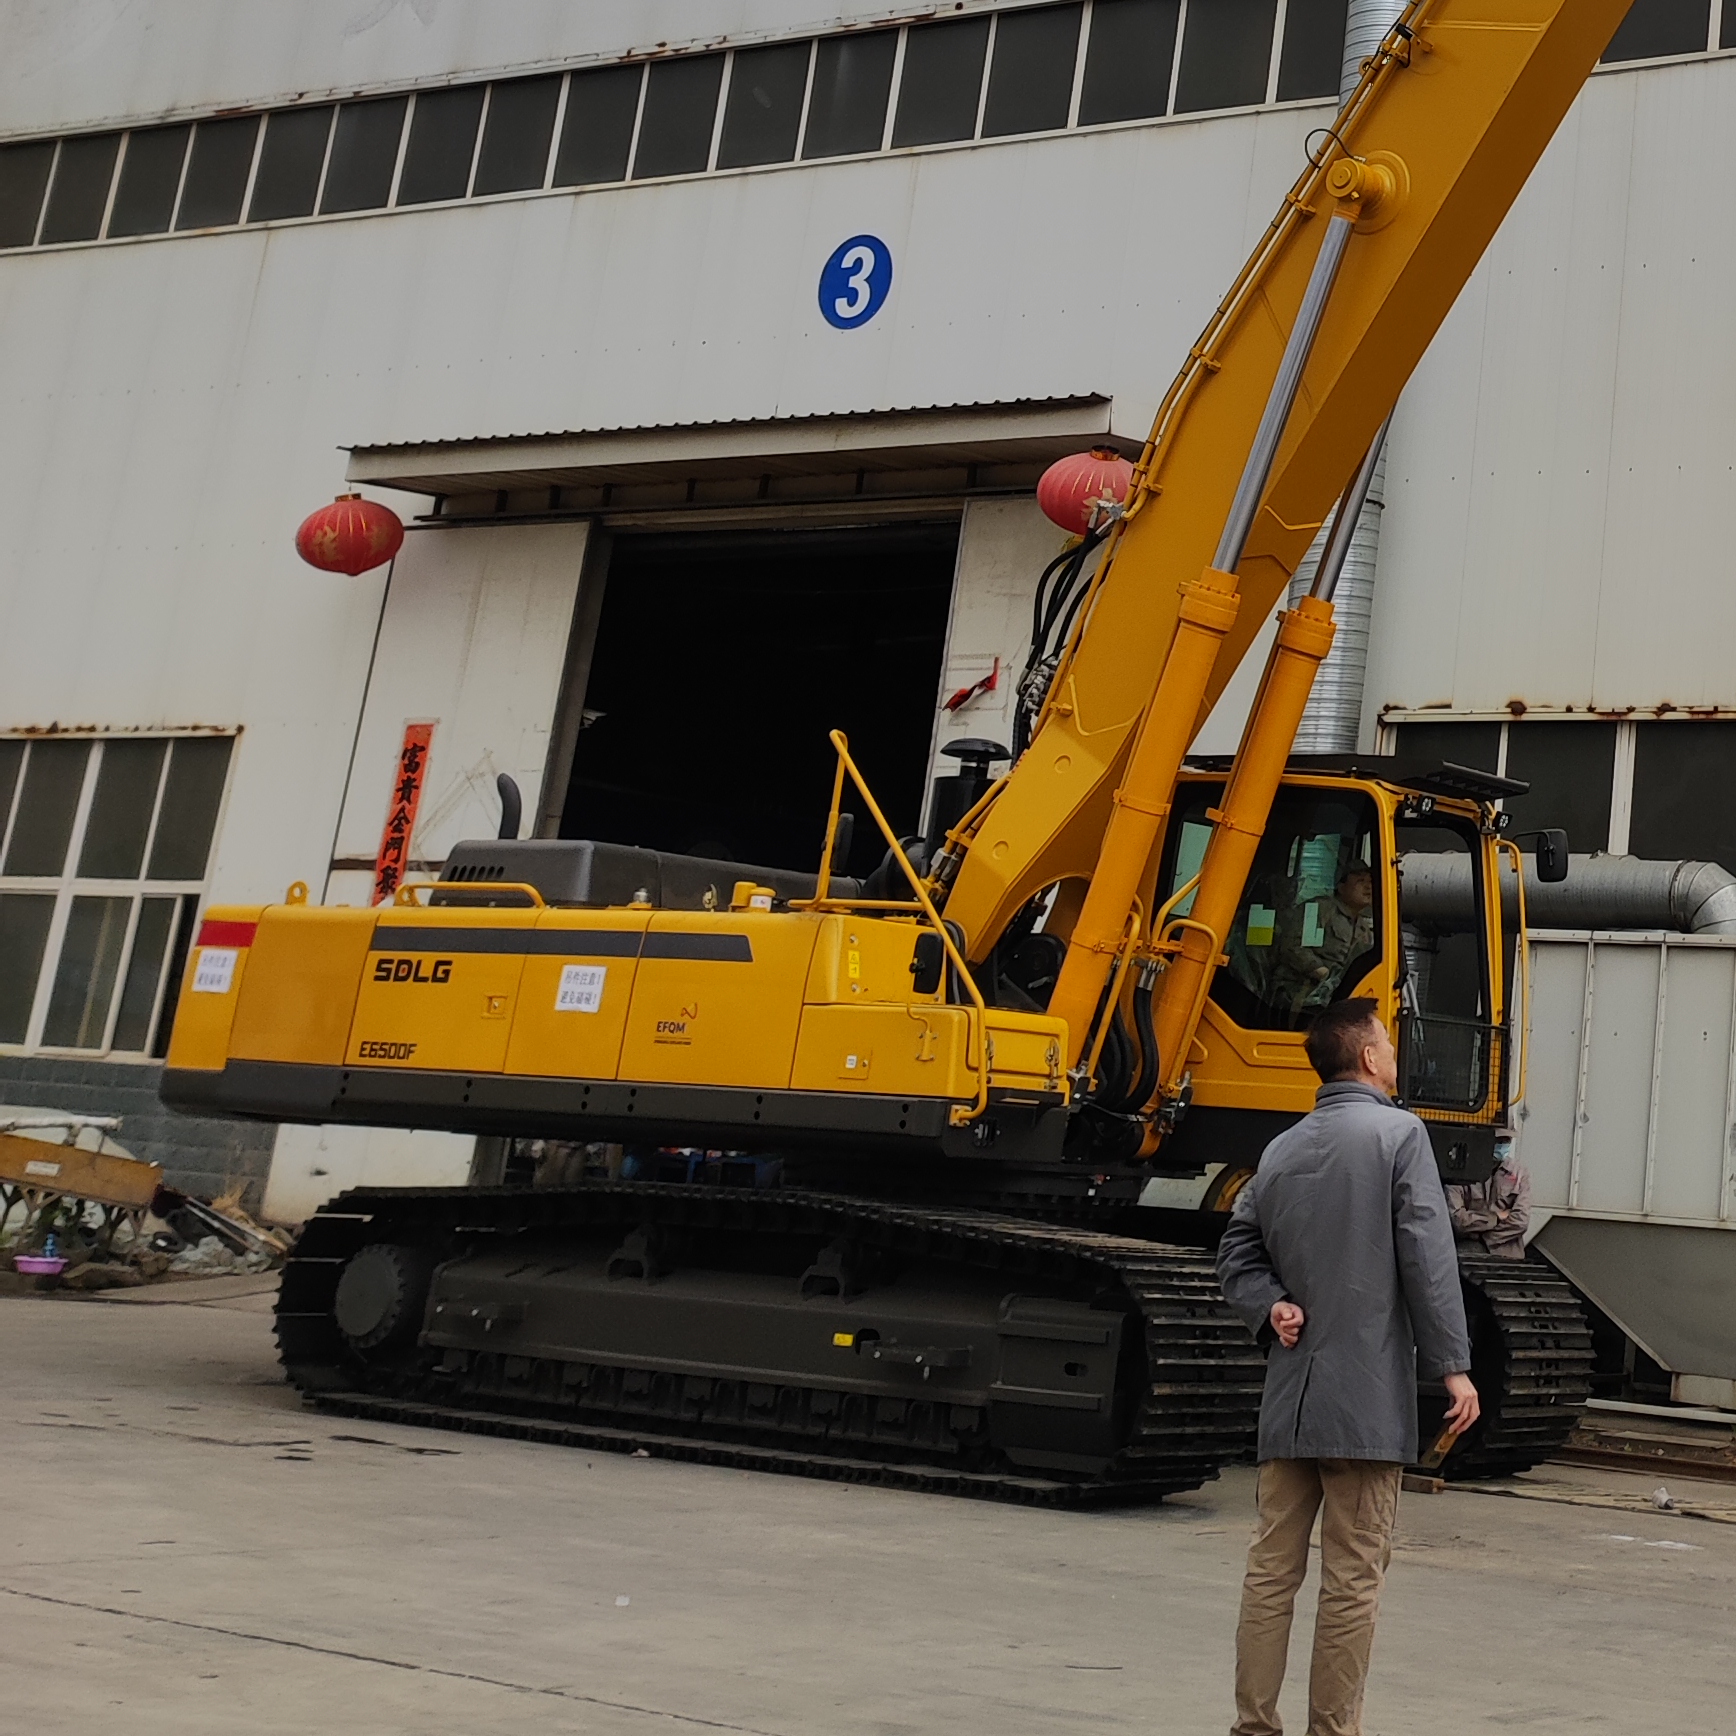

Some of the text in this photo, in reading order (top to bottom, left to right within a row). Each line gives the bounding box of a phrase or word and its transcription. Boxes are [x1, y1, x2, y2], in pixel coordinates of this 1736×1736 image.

[834, 244, 875, 319] 3
[373, 958, 453, 983] SDLG
[657, 1021, 686, 1033] EFQM
[359, 1040, 417, 1060] E6500F
